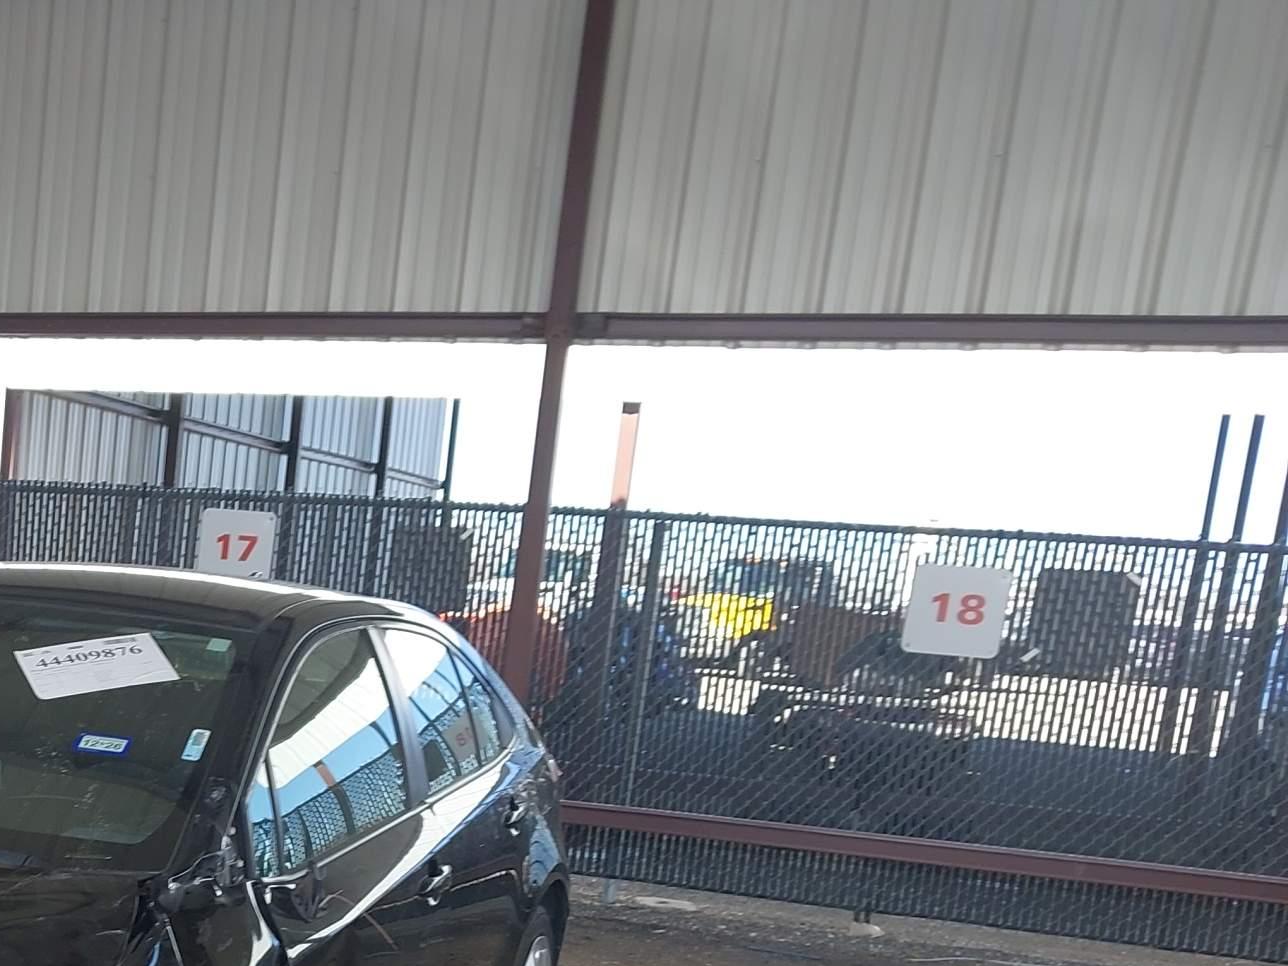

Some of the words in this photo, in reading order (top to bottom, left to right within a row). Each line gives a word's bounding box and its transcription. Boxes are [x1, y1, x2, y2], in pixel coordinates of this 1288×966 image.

[216, 533, 259, 562] 17
[931, 592, 987, 626] 18
[35, 645, 143, 668] 44409876
